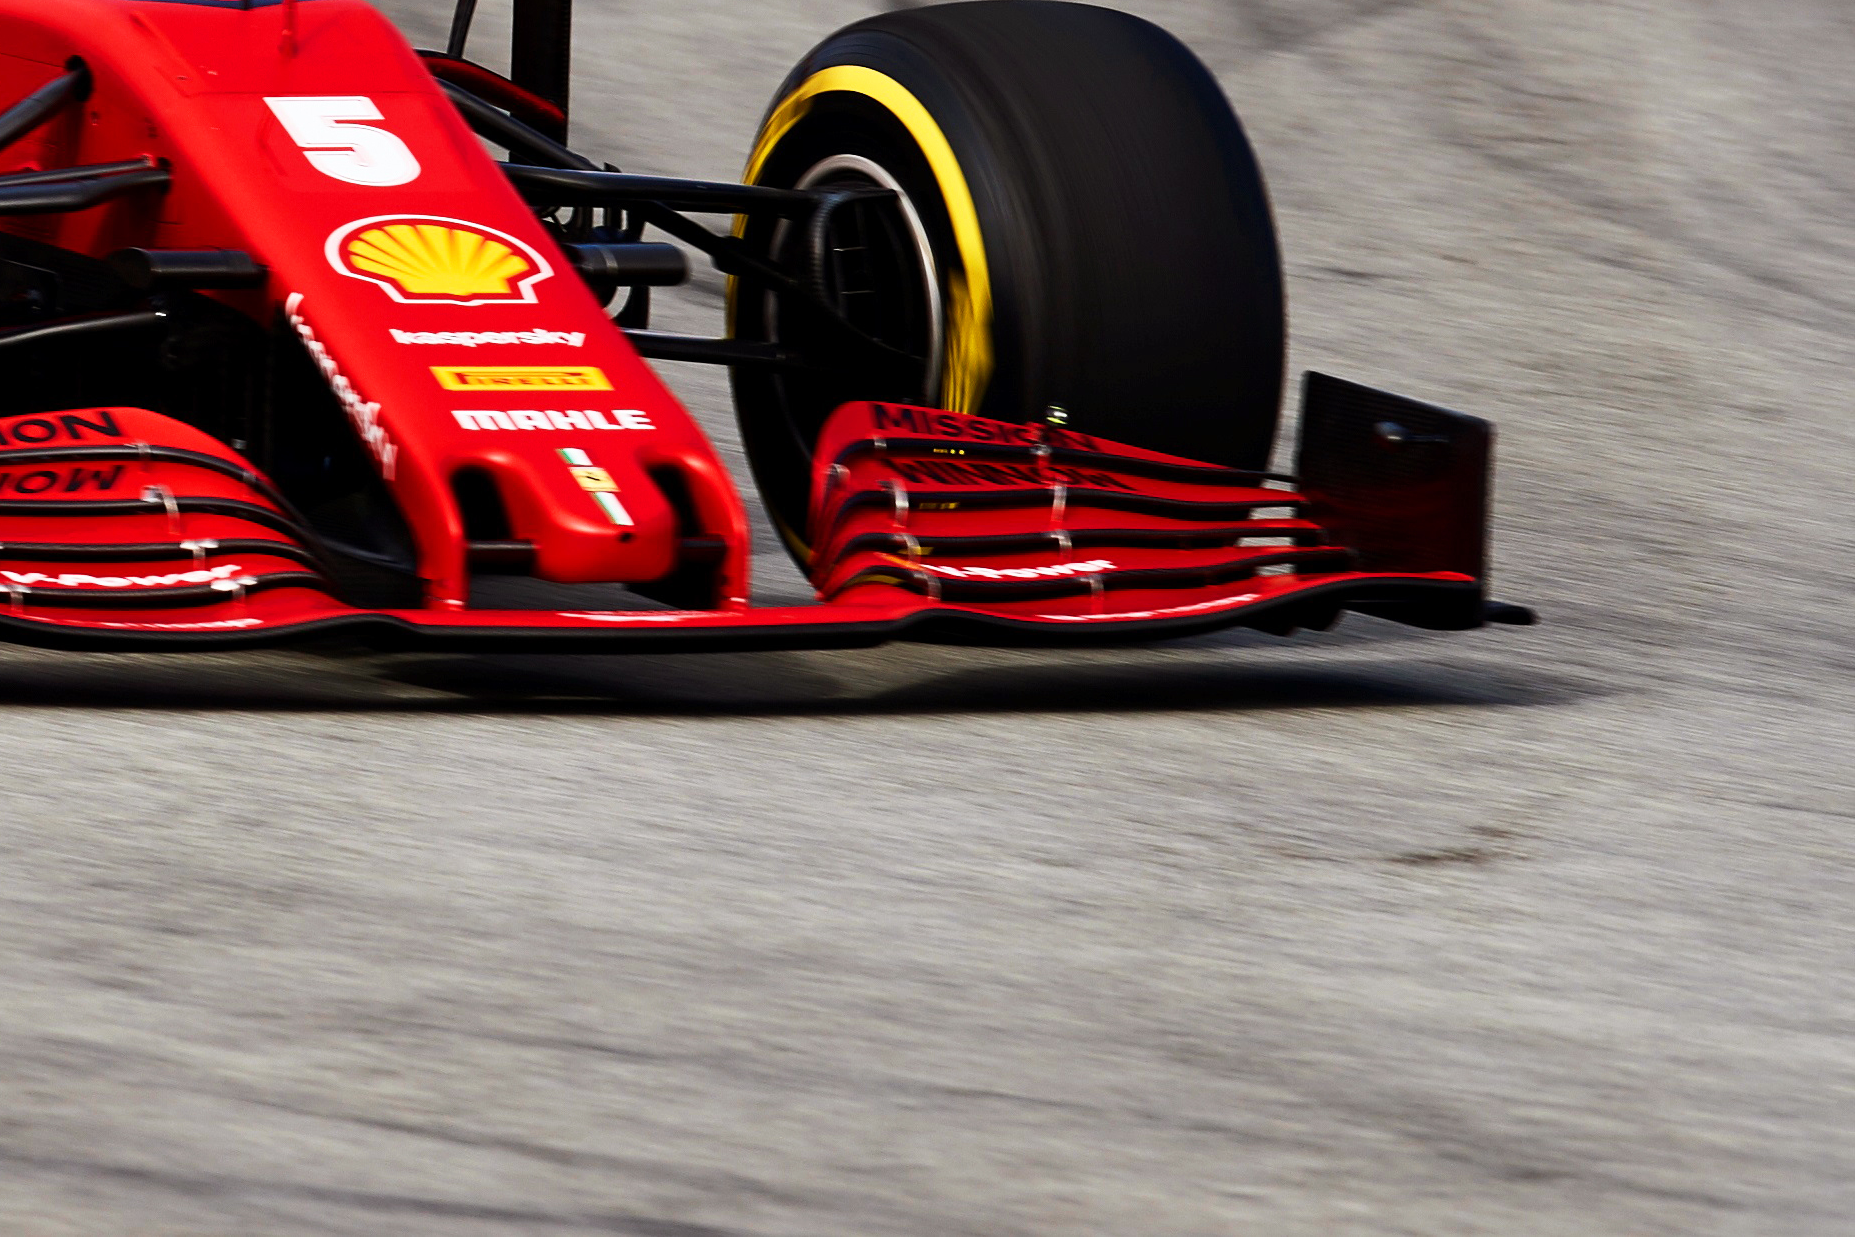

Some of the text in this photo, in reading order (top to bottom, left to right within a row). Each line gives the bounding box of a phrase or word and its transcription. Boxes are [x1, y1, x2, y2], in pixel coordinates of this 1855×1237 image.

[263, 96, 422, 187] 5
[389, 328, 587, 348] kaspersky
[451, 409, 657, 431] MAHLE
